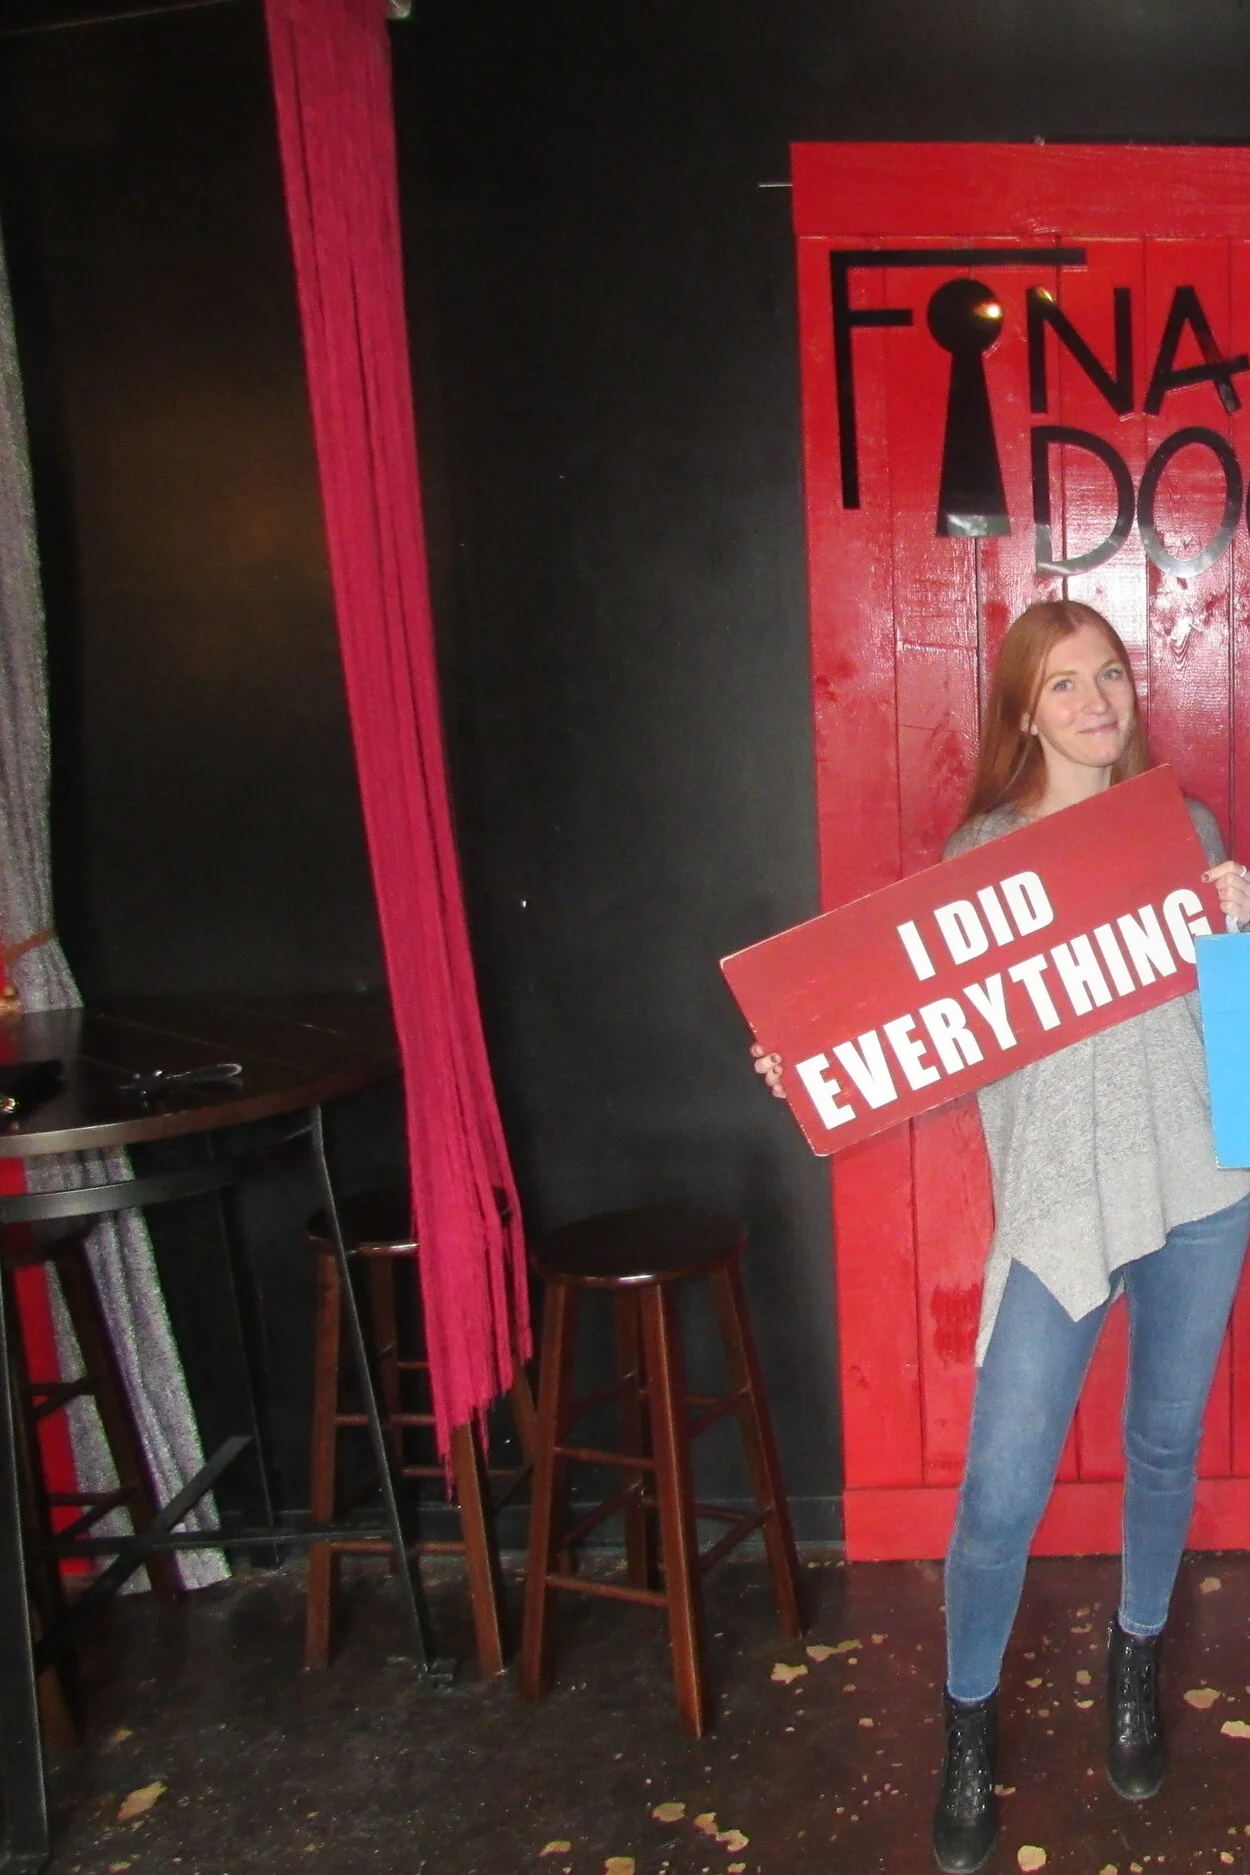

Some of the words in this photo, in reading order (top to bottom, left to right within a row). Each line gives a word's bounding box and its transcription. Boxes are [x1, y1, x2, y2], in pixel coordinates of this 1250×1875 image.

[796, 889, 1212, 1130] EVERYTHING
[897, 920, 936, 981] I
[934, 871, 1054, 965] DID
